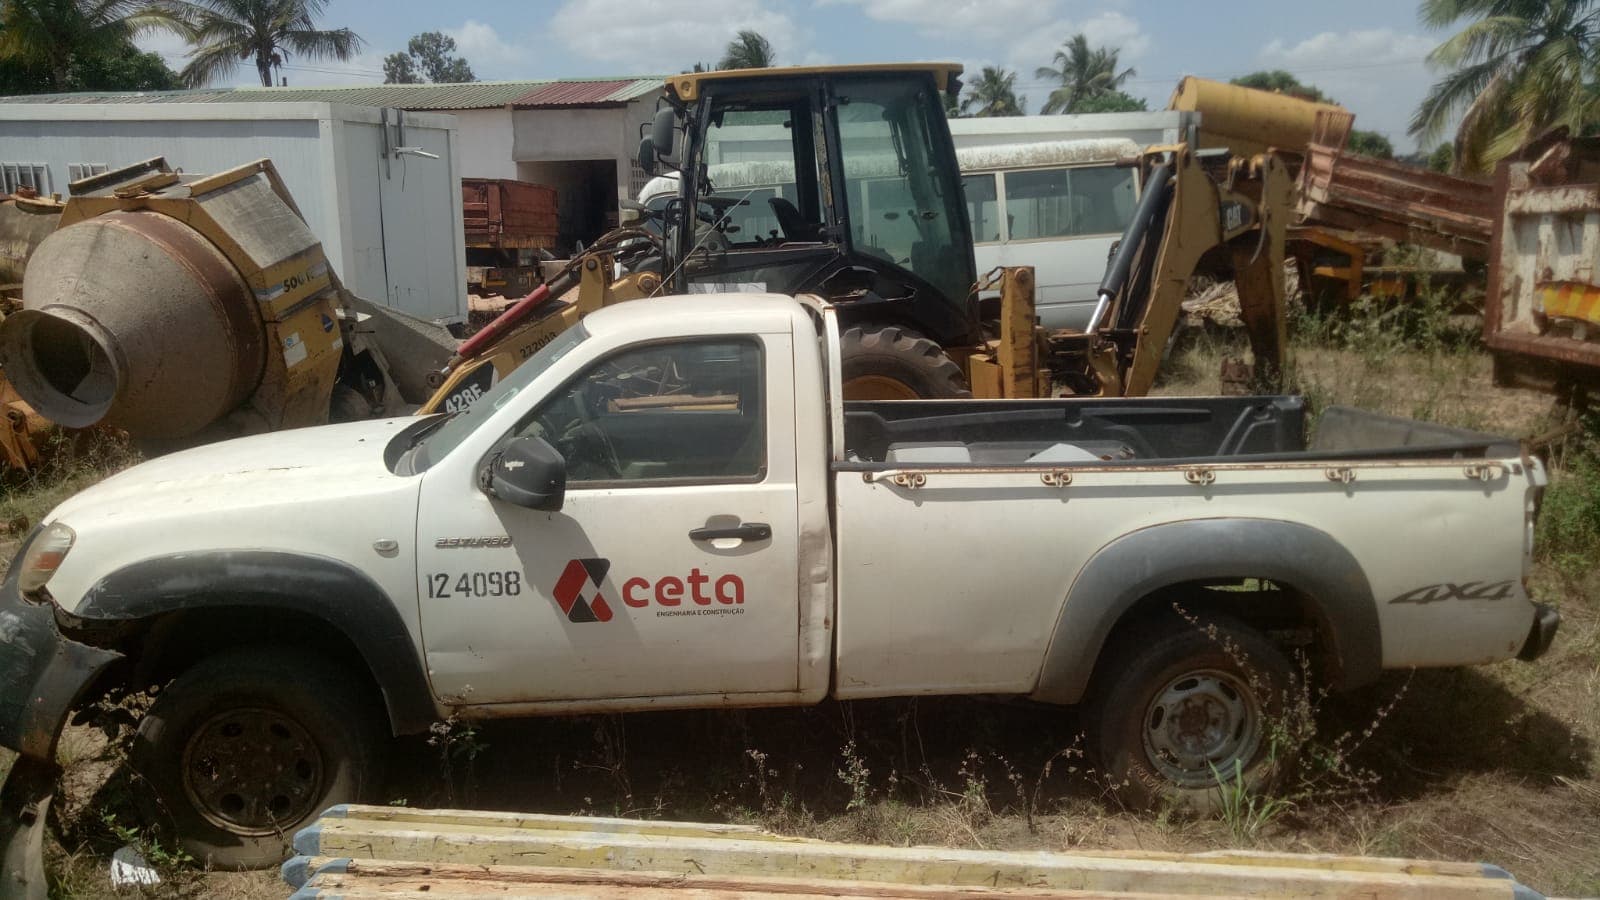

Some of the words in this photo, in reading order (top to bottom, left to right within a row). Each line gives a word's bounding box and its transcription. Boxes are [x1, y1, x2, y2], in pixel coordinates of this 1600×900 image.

[622, 567, 745, 608] ceta
[656, 609, 697, 617] ENGENHARIA
[702, 607, 745, 616] CONSTRUÇÃO
